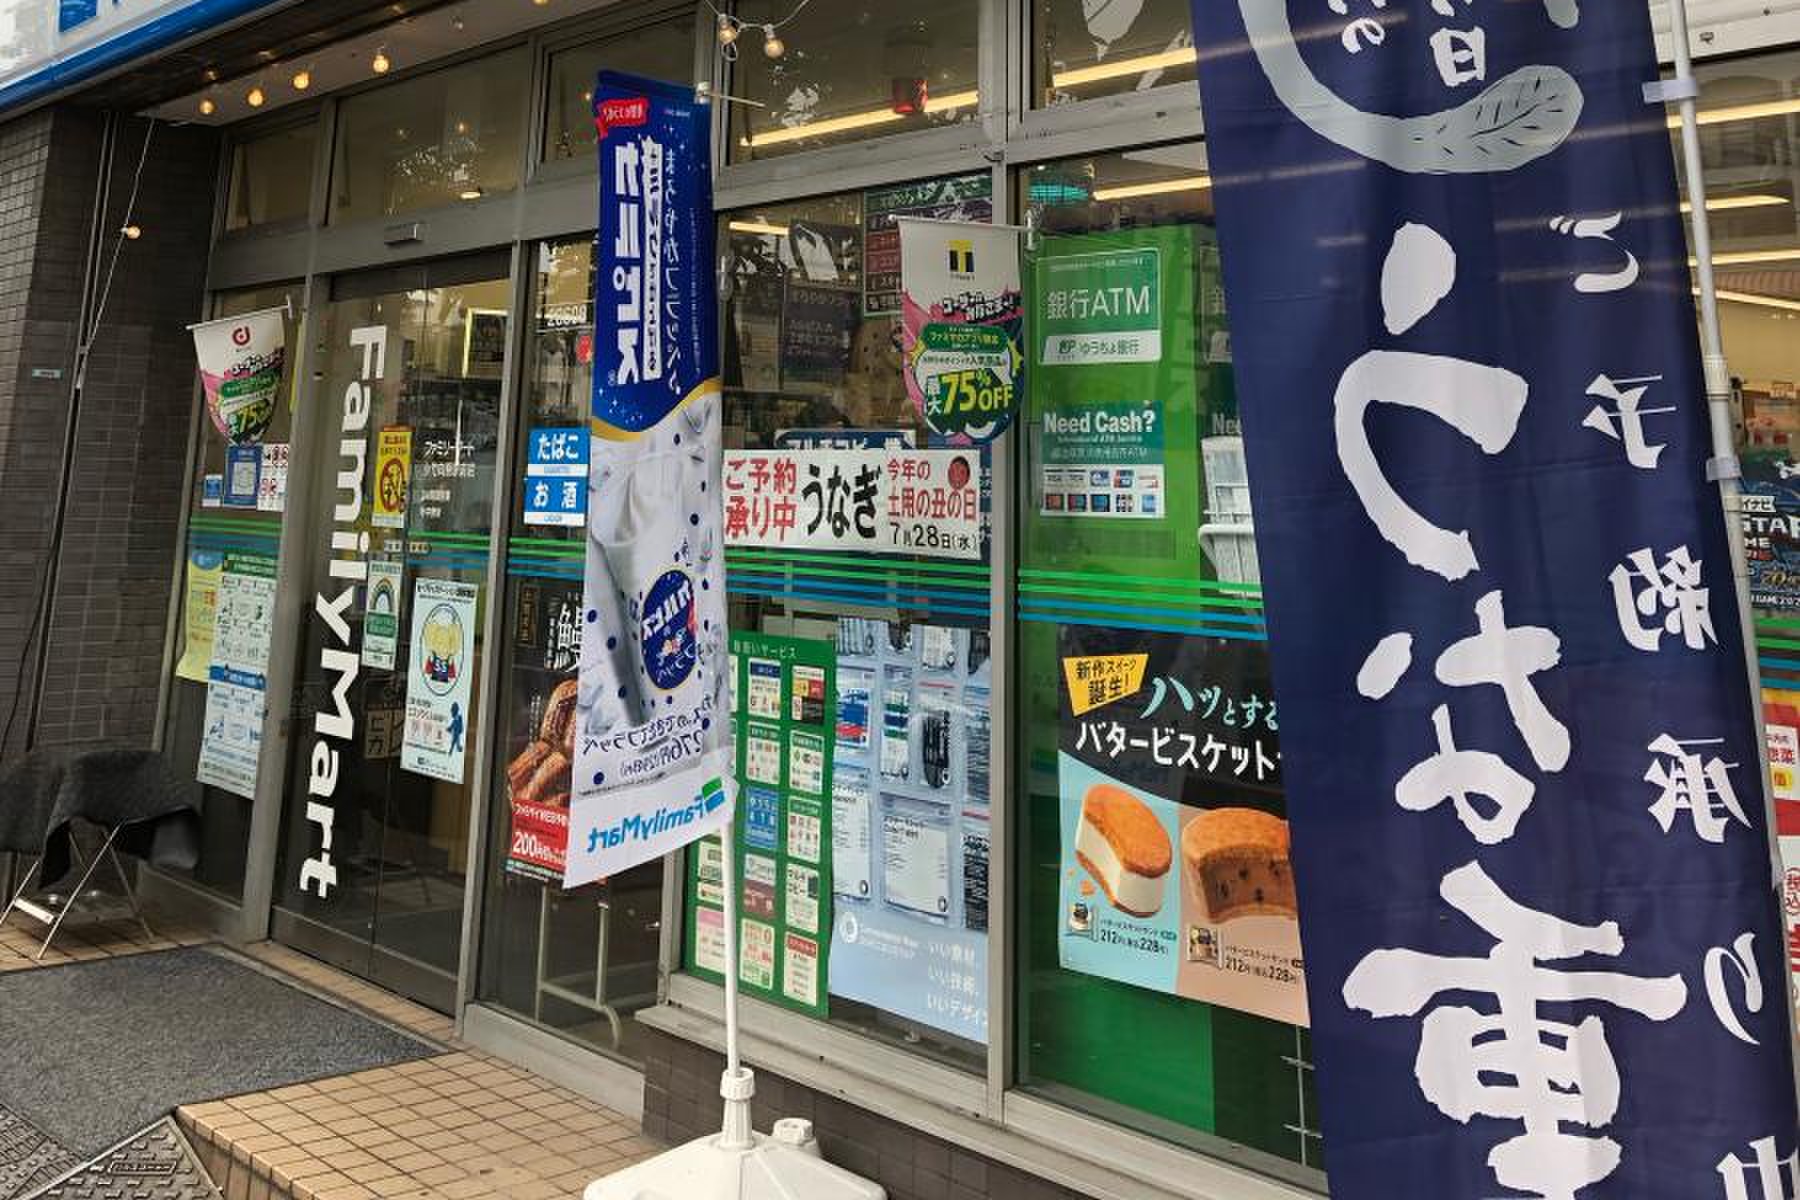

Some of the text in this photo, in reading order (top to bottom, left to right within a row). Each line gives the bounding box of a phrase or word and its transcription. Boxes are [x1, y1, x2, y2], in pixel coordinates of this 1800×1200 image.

[1047, 286, 1150, 320] 銀行ATM
[1043, 409, 1156, 433] Need Cash?
[537, 432, 579, 460] たばこ
[725, 458, 797, 494] ご予約
[887, 458, 930, 481] 今年の
[533, 481, 577, 509] お酒
[802, 464, 882, 539] うなぎ
[887, 484, 977, 521] 土用の丑の日
[725, 495, 797, 541] 承り中
[299, 325, 387, 898] FamilyMart
[1076, 660, 1137, 680] 新作スイーツ
[1139, 674, 1279, 731] ハッとする
[1075, 721, 1281, 781] バタービスケット
